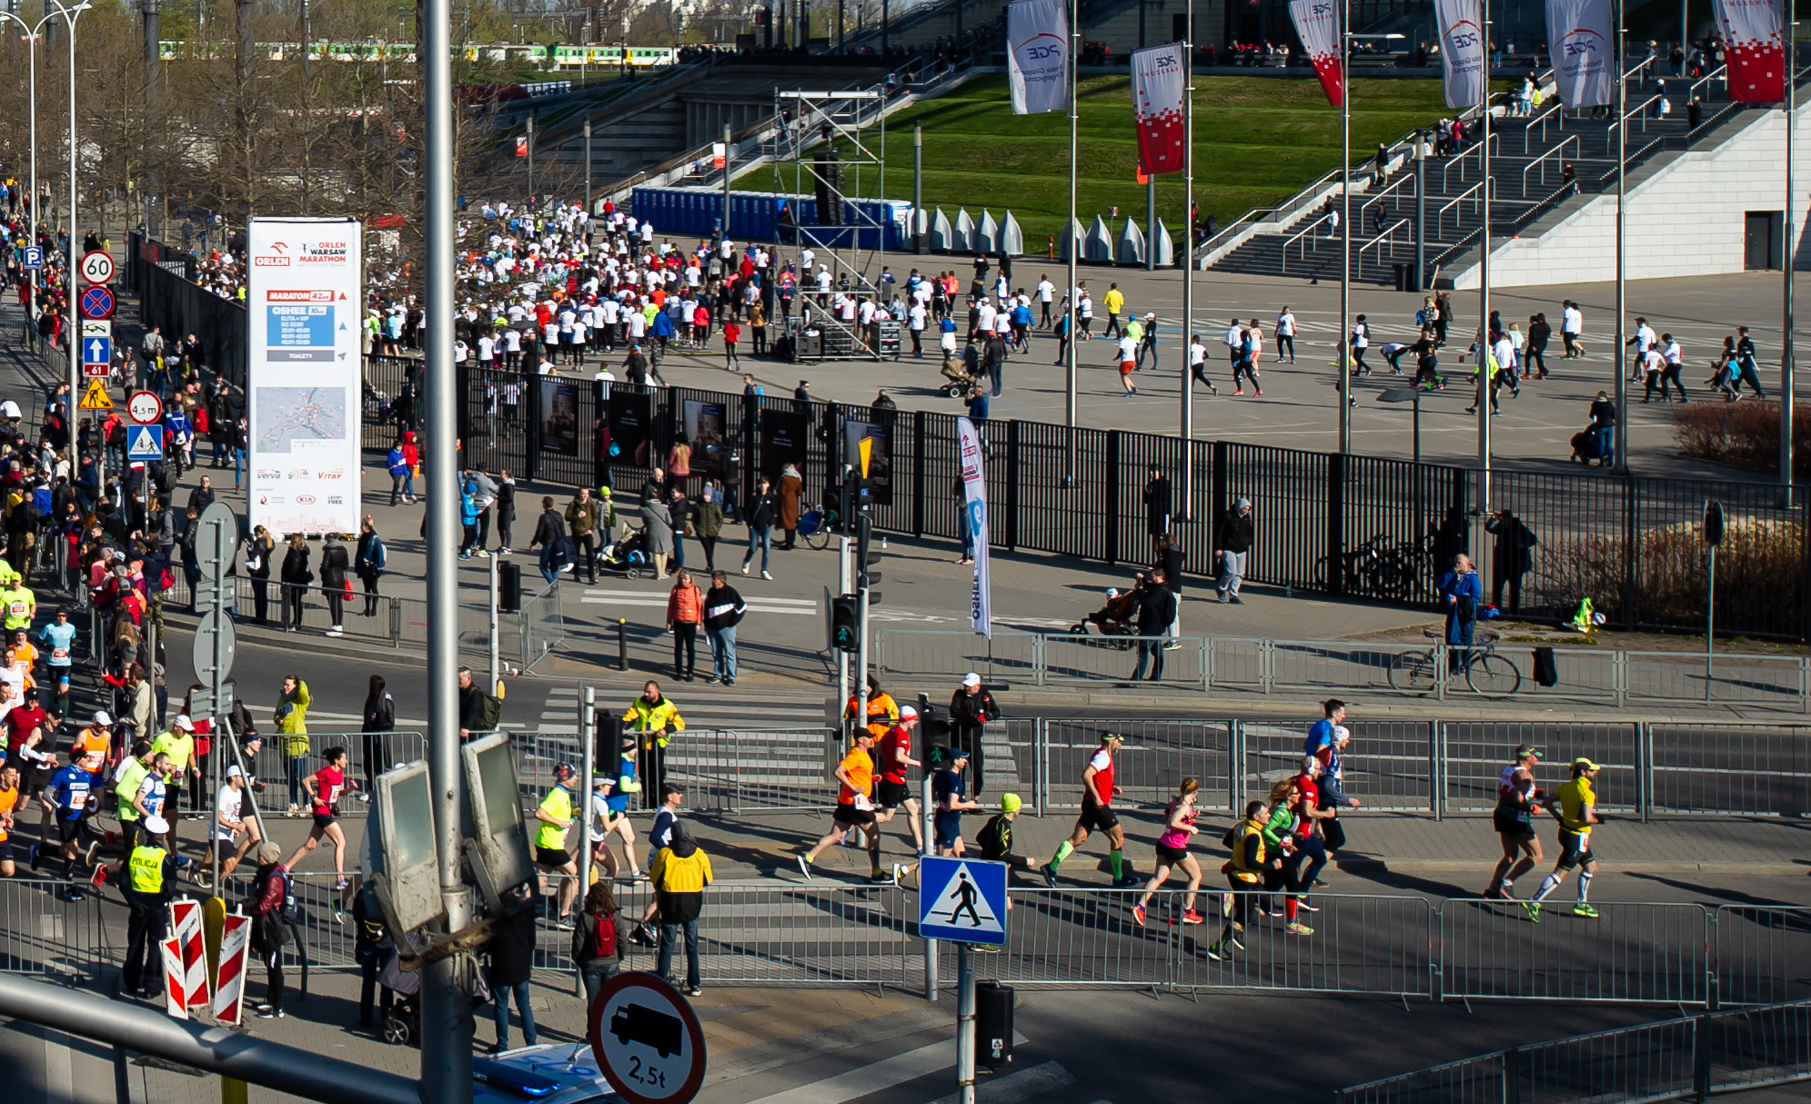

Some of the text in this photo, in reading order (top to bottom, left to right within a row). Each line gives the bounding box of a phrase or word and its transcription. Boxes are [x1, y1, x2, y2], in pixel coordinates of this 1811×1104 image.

[255, 257, 290, 266] ORLEN
[87, 259, 109, 276] 60
[269, 292, 310, 300] MARATON
[272, 307, 307, 315] OSHEE
[91, 366, 102, 375] 61
[132, 405, 146, 415] 4,5
[132, 856, 158, 869] POLICJA
[628, 1055, 666, 1089] 2,5t
